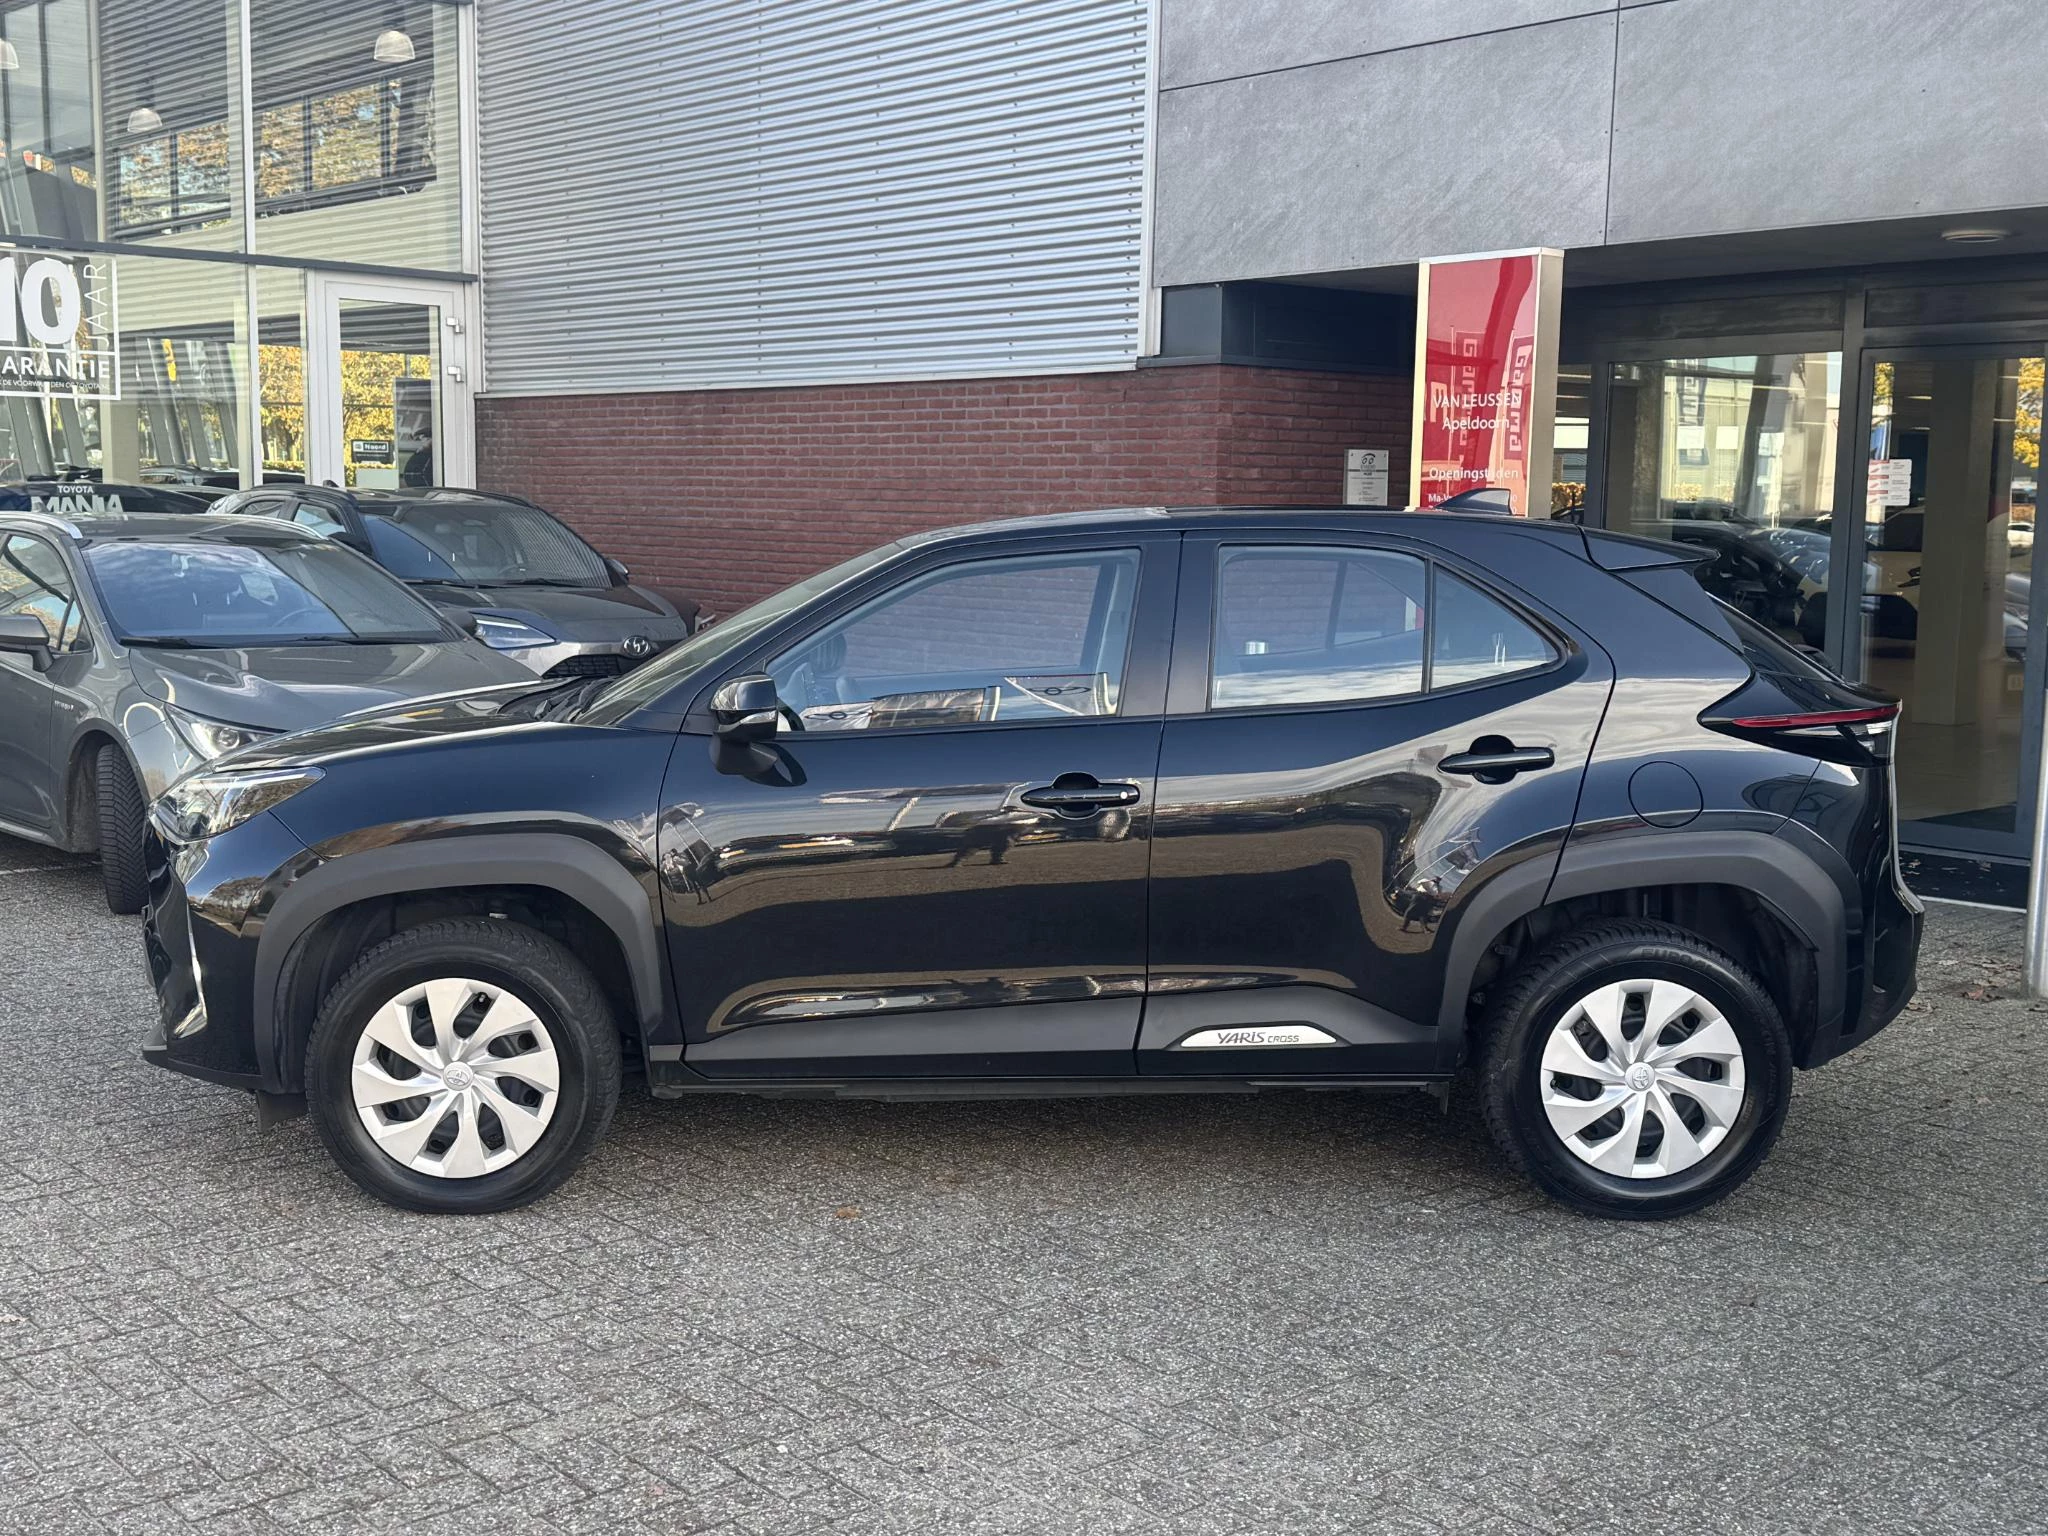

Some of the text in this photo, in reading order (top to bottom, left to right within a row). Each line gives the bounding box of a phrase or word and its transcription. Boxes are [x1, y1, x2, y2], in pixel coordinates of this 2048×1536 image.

[0, 257, 81, 344] 10
[83, 263, 110, 347] JAAR
[0, 355, 110, 380] ARANTIE
[12, 379, 65, 388] VOORWAADEN
[1433, 392, 1521, 408] VAN LEUSSEN
[1442, 416, 1510, 431] Apeldoorn
[1429, 466, 1519, 482] Openingstden
[57, 485, 94, 494] TOYOTA
[31, 494, 124, 513] MANIA
[1217, 1031, 1300, 1045] YARIS CROSS
